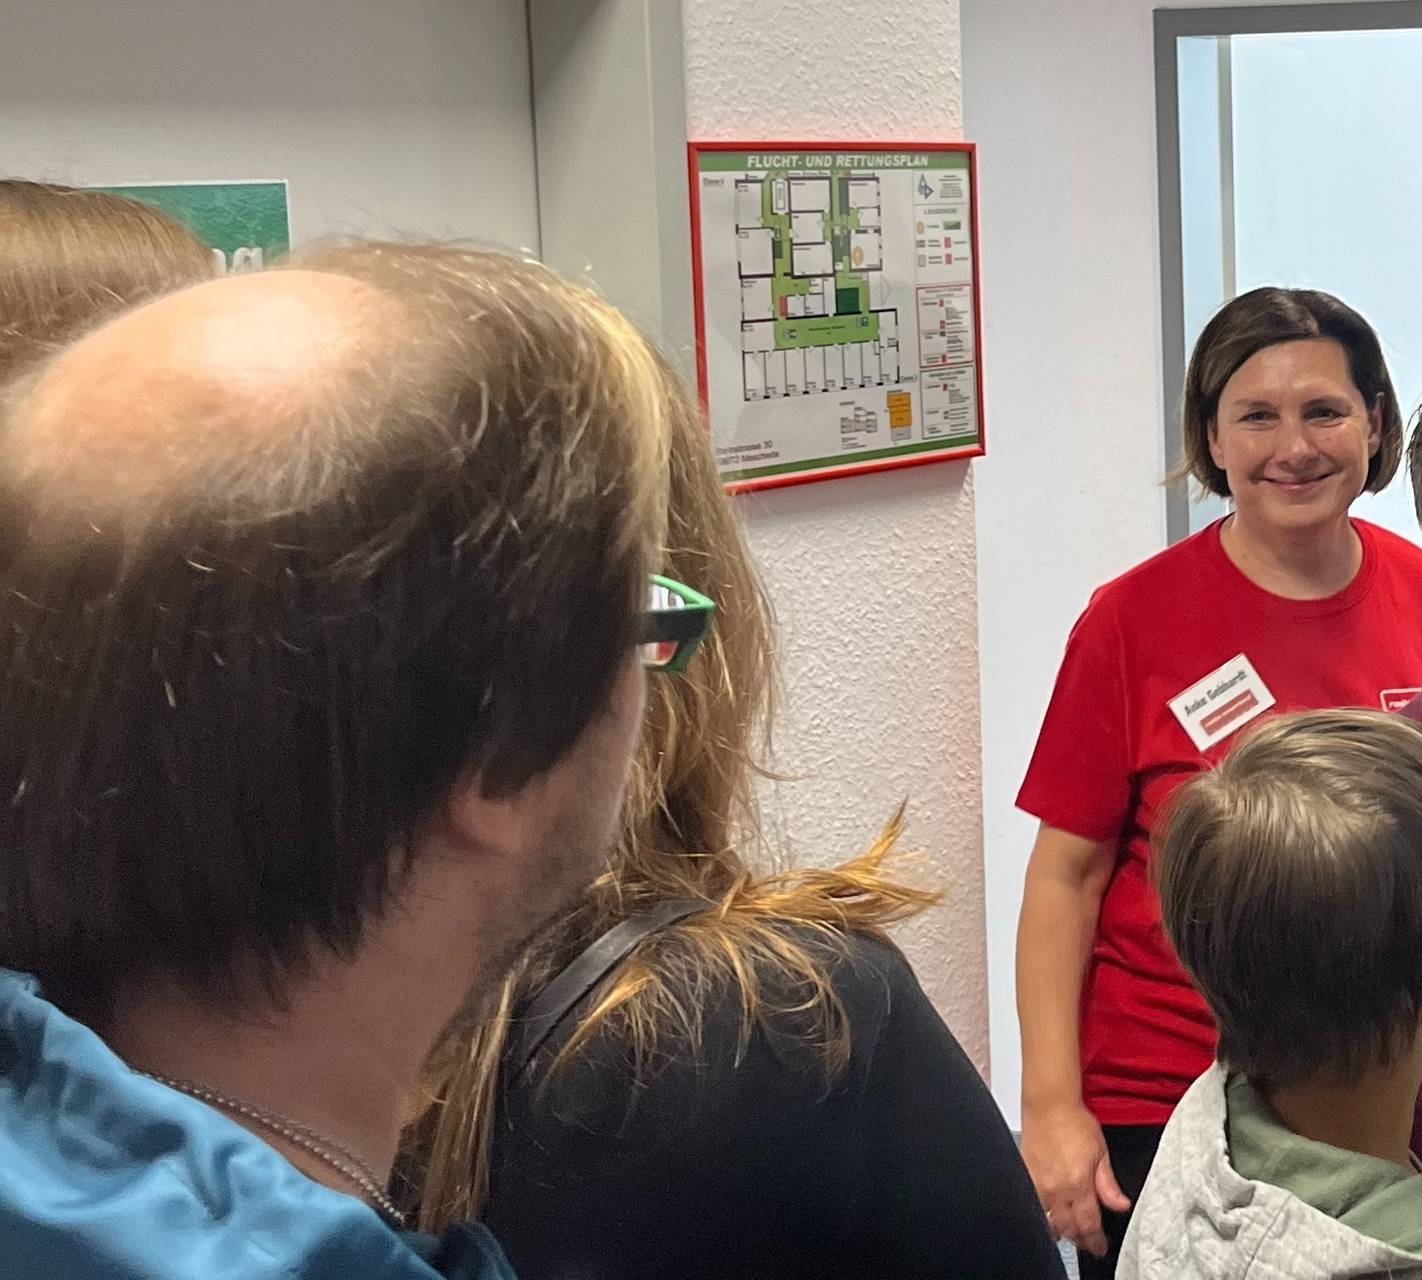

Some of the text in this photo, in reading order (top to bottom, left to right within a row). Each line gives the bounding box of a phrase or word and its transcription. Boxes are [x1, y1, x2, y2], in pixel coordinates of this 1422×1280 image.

[747, 154, 929, 168] FLUCHT- UND RETTUNGSPLAN
